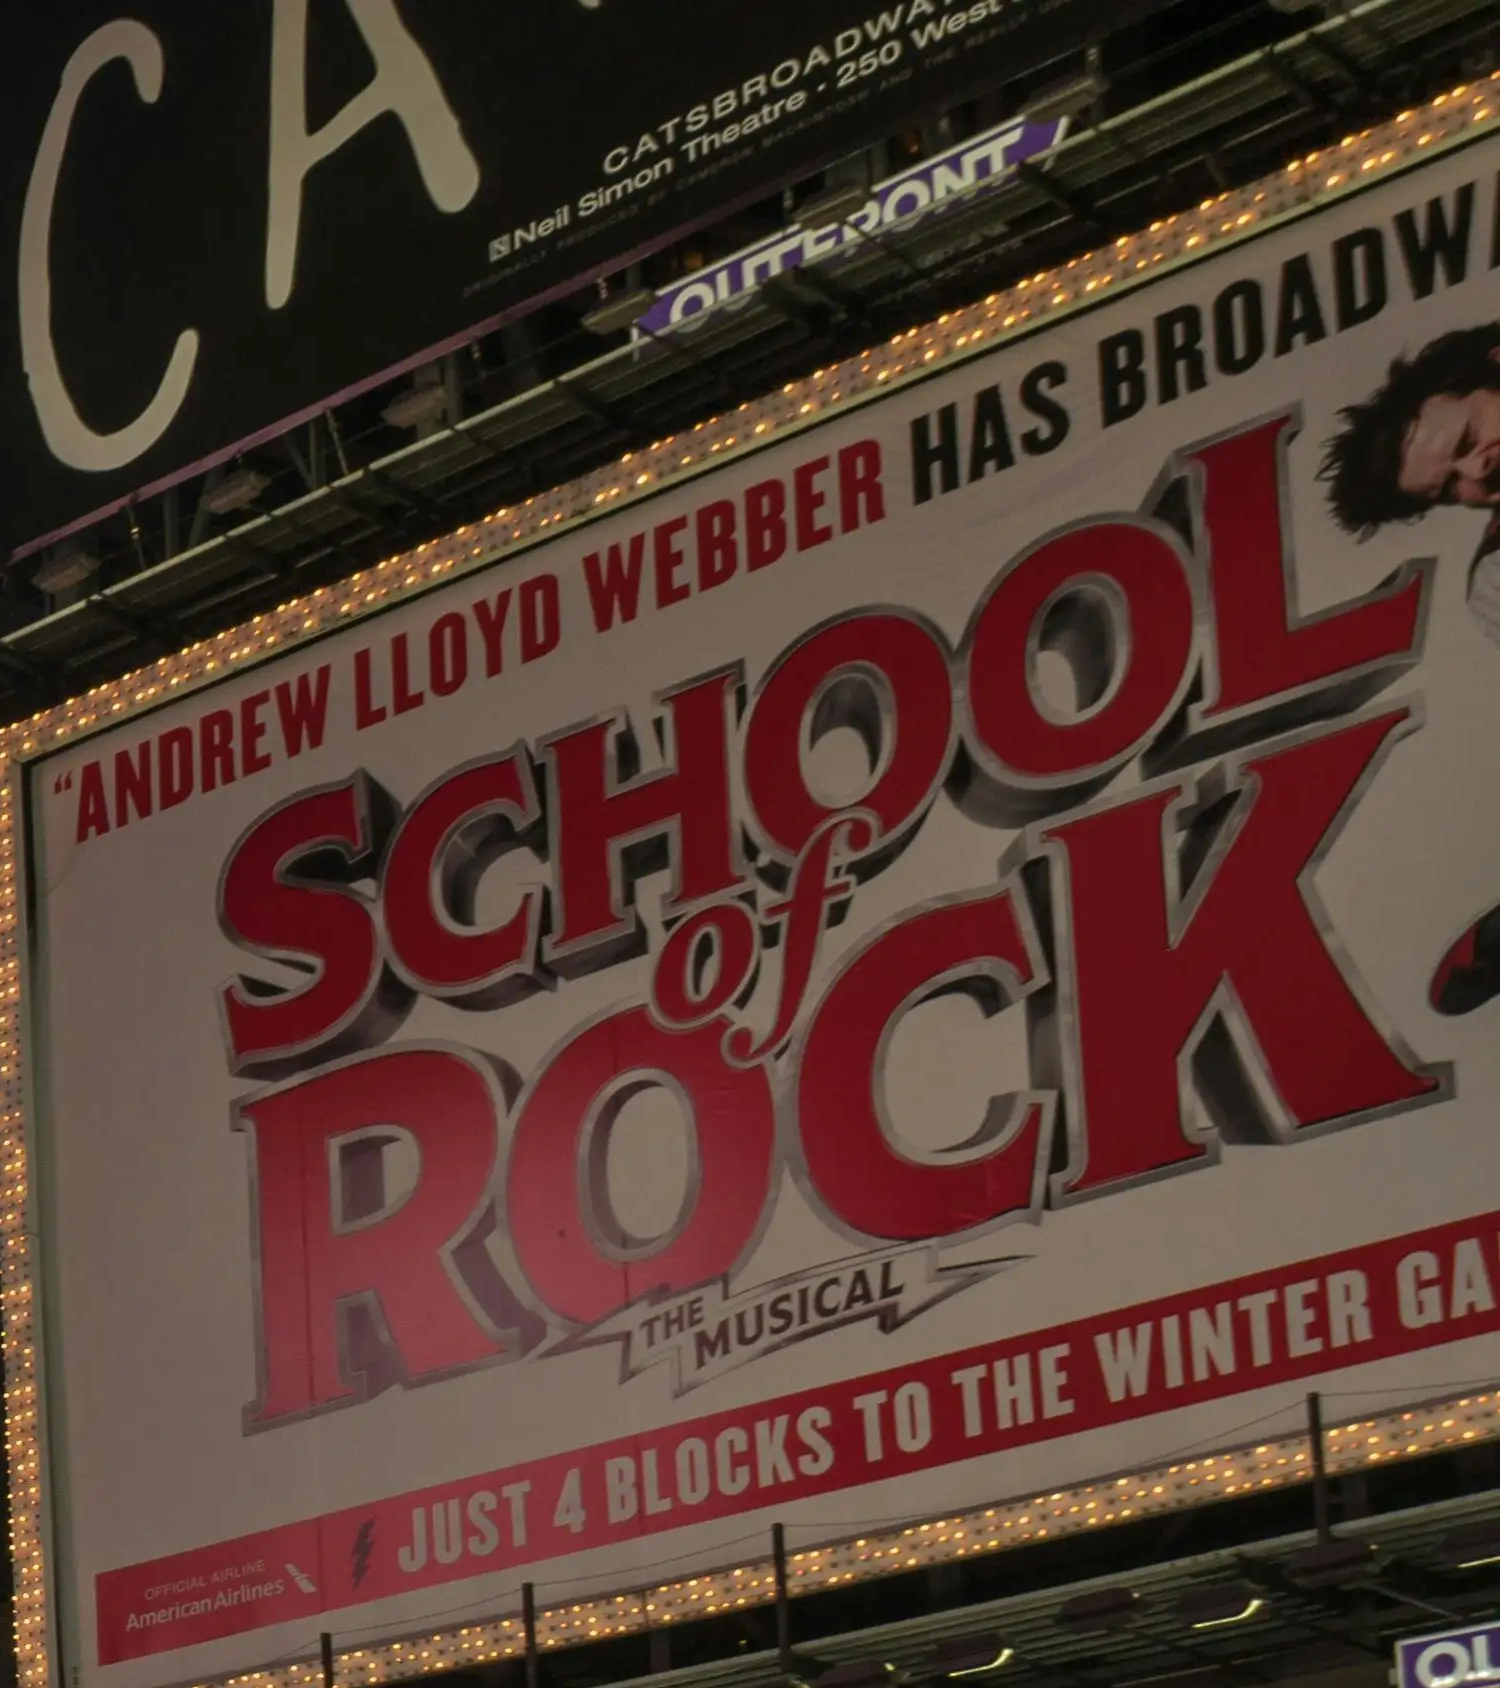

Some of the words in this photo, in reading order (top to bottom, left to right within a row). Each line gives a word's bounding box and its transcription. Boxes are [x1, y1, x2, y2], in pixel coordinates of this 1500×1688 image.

[511, 203, 571, 251] Neil
[577, 152, 675, 220] Simon
[680, 84, 806, 166] Theatre
[835, 39, 904, 91] 250
[909, 0, 1003, 56] West
[351, 572, 563, 732] LLOYD
[582, 437, 887, 635] WEBBER
[909, 361, 1070, 506] HAS
[215, 401, 1438, 1079] SCHOOL
[651, 808, 883, 1070] of
[231, 705, 1457, 1437] ROCK
[398, 1481, 532, 1573] JUST
[552, 1469, 587, 1534] 4
[606, 1406, 836, 1524] BLOCKS
[853, 1381, 931, 1463] TO
[951, 1342, 1076, 1439] THE
[1094, 1269, 1374, 1404] WINTER
[639, 1297, 707, 1350] THE
[694, 1259, 906, 1369] MUSICAL
[124, 1592, 212, 1631] American
[214, 1577, 286, 1612] Airlines
[144, 1574, 206, 1601] OFFICIAL
[211, 1558, 267, 1588] AIRLINE
